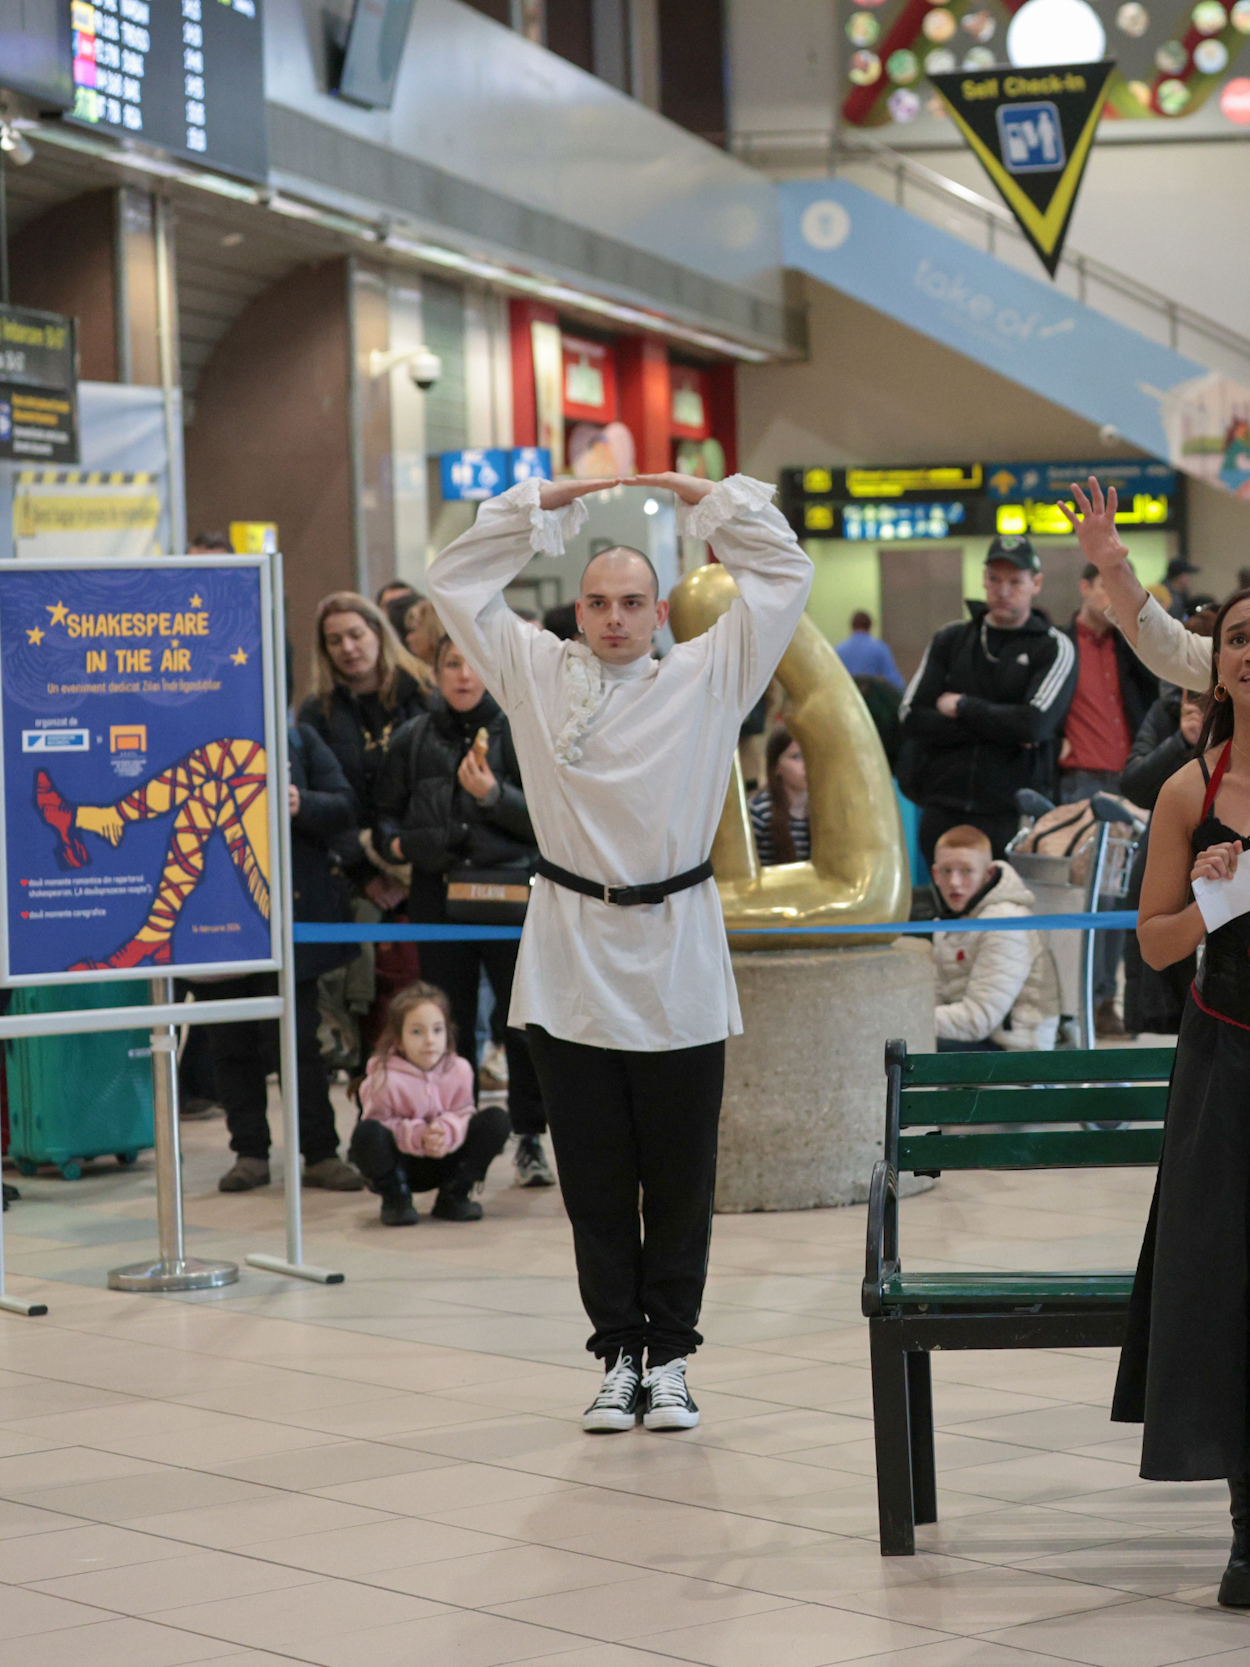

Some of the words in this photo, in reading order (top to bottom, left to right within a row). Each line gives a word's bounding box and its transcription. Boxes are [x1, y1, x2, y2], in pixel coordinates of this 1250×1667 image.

[961, 77, 999, 100] Self
[1003, 72, 1086, 97] Check-in
[66, 612, 210, 638] SHAKESPEARE
[86, 649, 107, 674] IN
[115, 648, 153, 674] THE
[160, 648, 192, 673] AIR
[47, 683, 60, 694] Un
[61, 680, 106, 694] eveniment
[108, 678, 141, 693] dedicat
